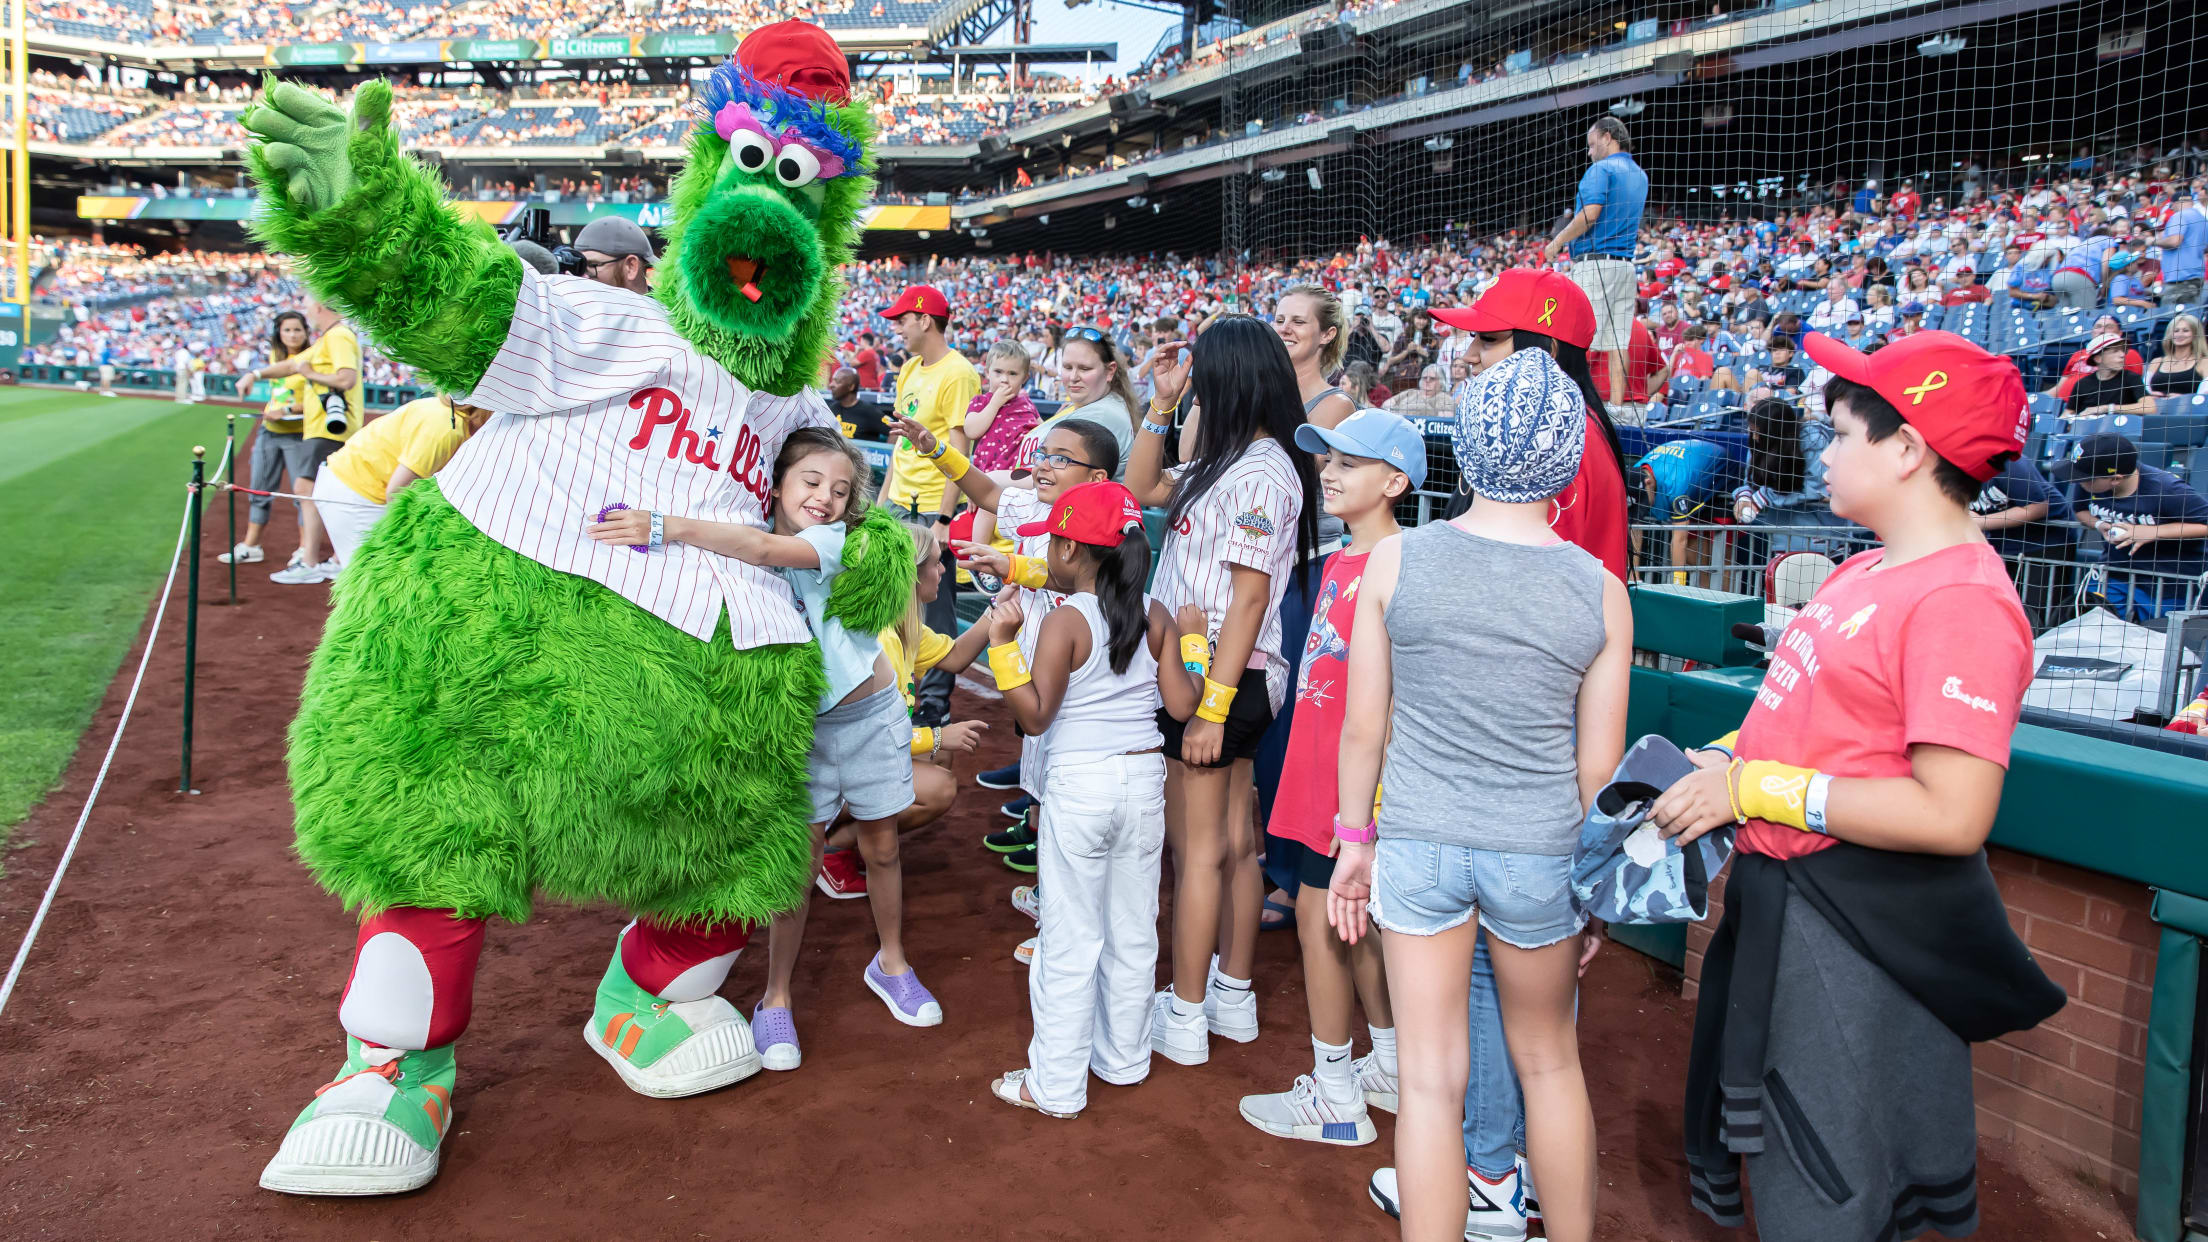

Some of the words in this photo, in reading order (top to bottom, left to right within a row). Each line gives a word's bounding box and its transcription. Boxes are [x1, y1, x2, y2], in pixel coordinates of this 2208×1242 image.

[567, 39, 624, 56] Citizens
[1427, 421, 1454, 435] Citize
[628, 386, 772, 522] Phillies
[1234, 515, 1275, 536] SERIES
[1227, 539, 1270, 556] CHAMPIONS
